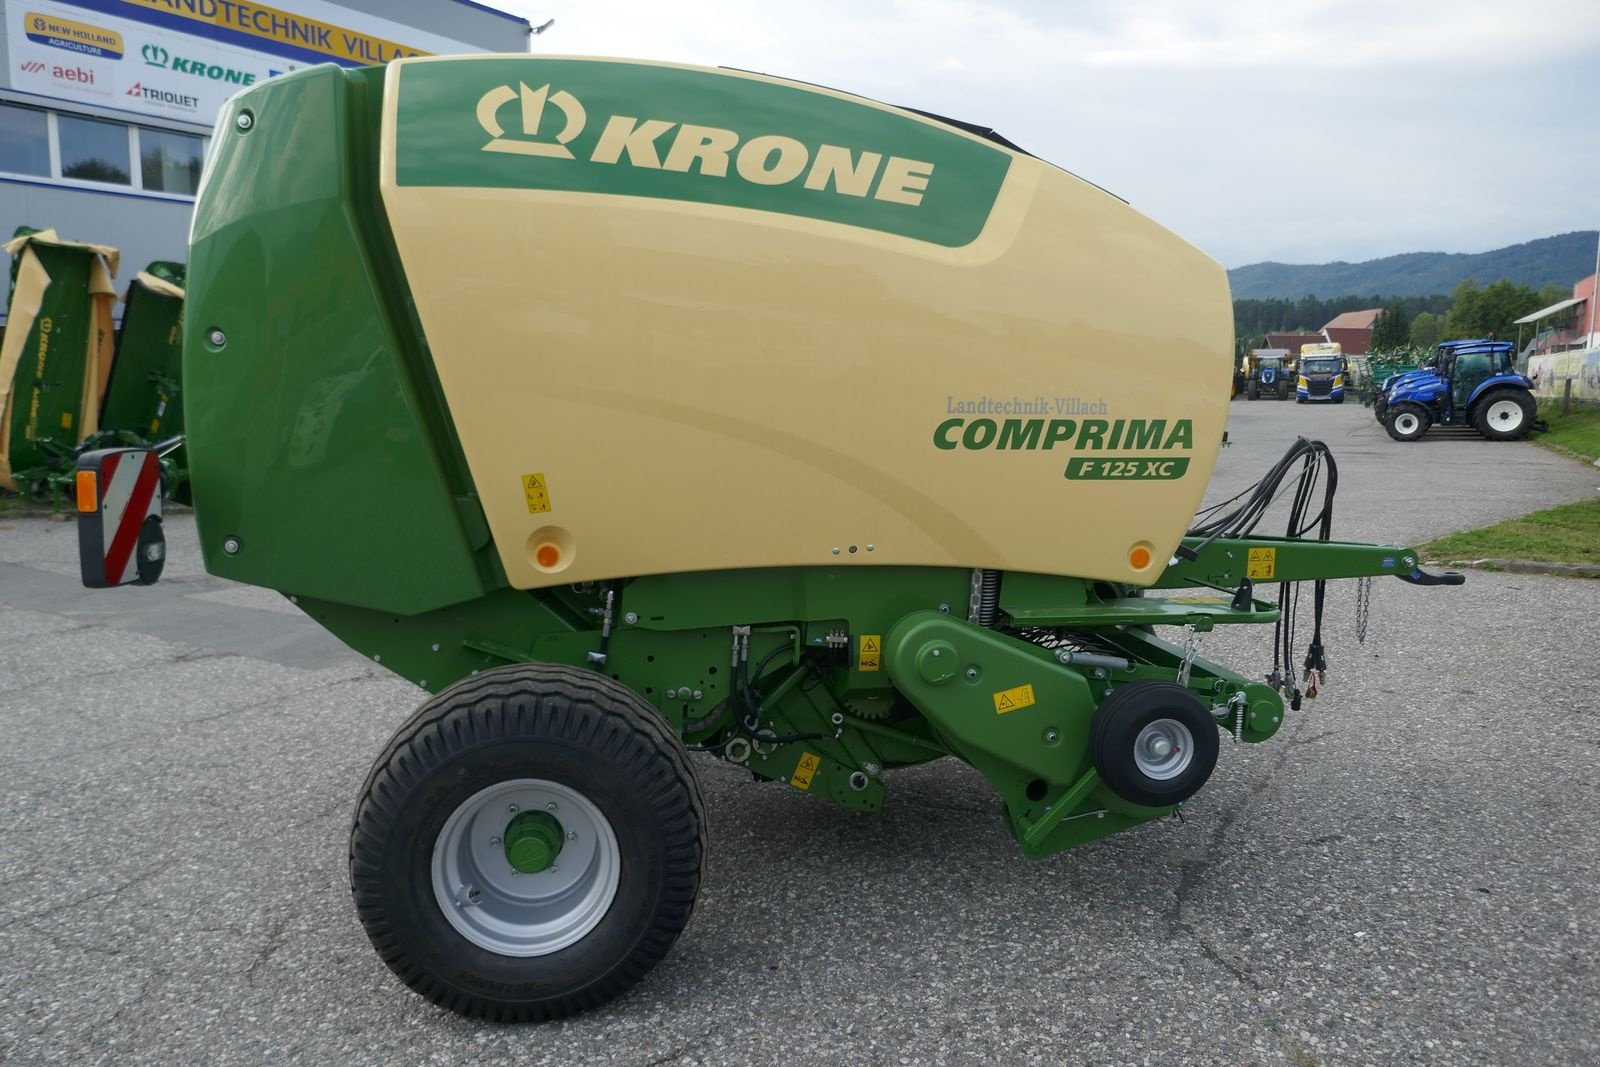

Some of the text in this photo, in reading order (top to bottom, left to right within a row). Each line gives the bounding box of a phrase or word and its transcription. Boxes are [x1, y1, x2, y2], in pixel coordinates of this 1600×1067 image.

[48, 23, 116, 46] NEW HOLLAND
[48, 38, 102, 56] AGRICULTURE
[53, 65, 95, 85] aebi
[171, 57, 256, 86] KRONE
[142, 87, 200, 108] TRIOLIET
[590, 115, 935, 206] KRONE
[946, 396, 1108, 416] Landtechnik-Villach
[933, 418, 1193, 450] COMPRIMA
[1078, 462, 1176, 477] F 125 XC
